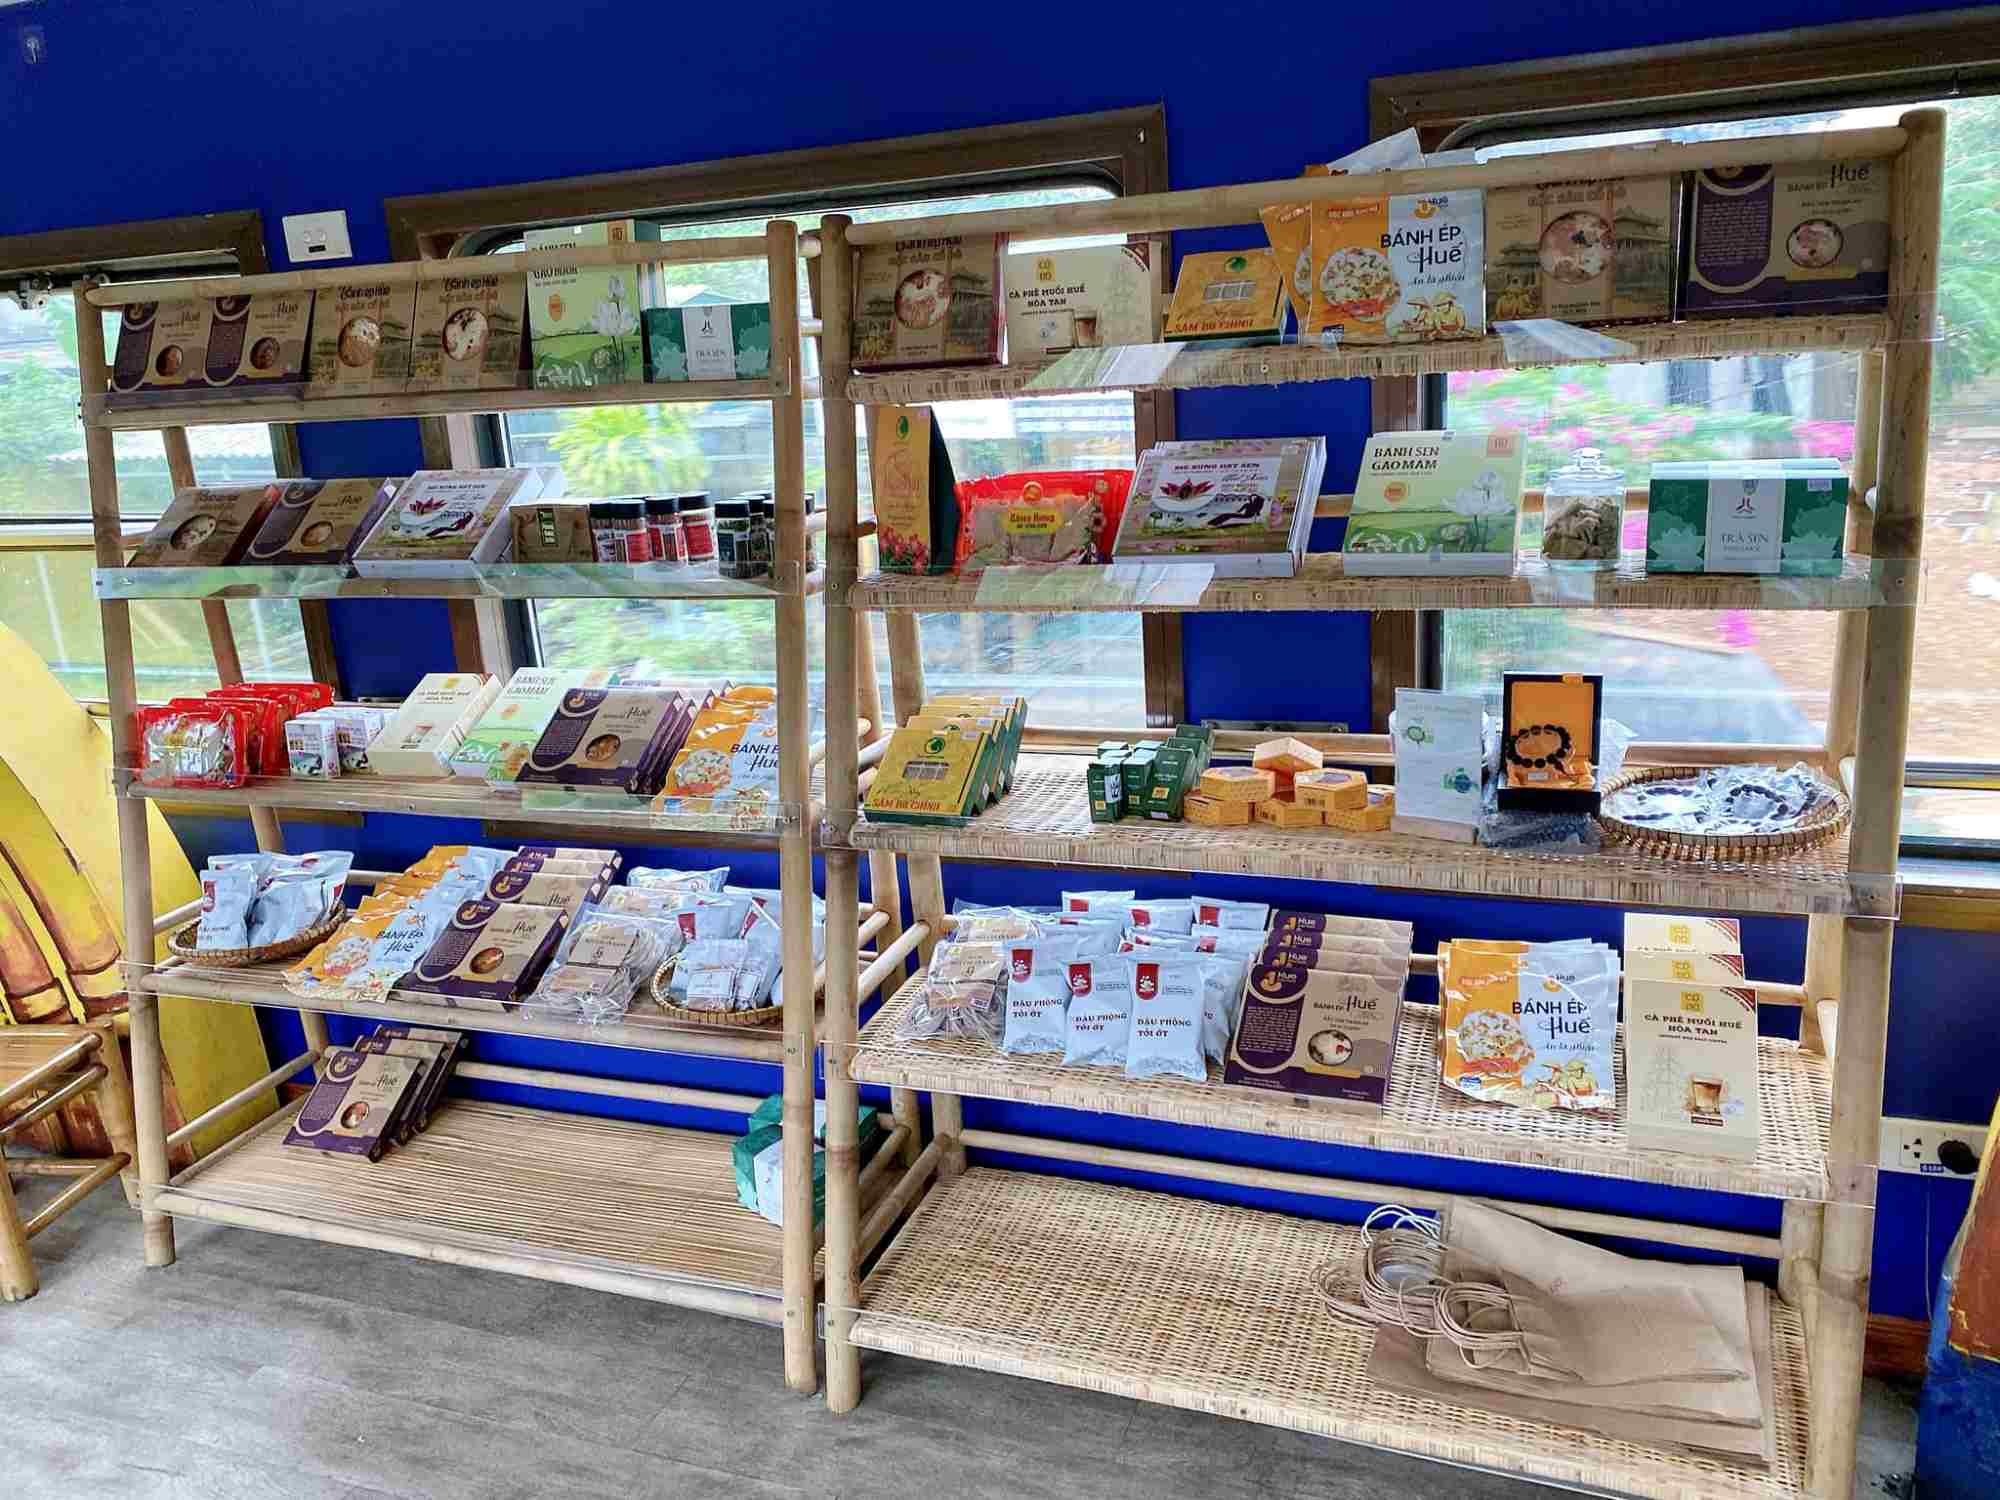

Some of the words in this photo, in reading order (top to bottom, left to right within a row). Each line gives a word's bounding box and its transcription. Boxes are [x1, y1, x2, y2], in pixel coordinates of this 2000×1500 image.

[1381, 228, 1433, 249] BÁNH
[1439, 223, 1461, 242] ÉP
[1407, 242, 1463, 273] Huế
[730, 741, 770, 755] BÁNH
[1512, 997, 1562, 1015] BÁNH
[1567, 997, 1588, 1015] ÉP
[1538, 1016, 1591, 1040] Huế
